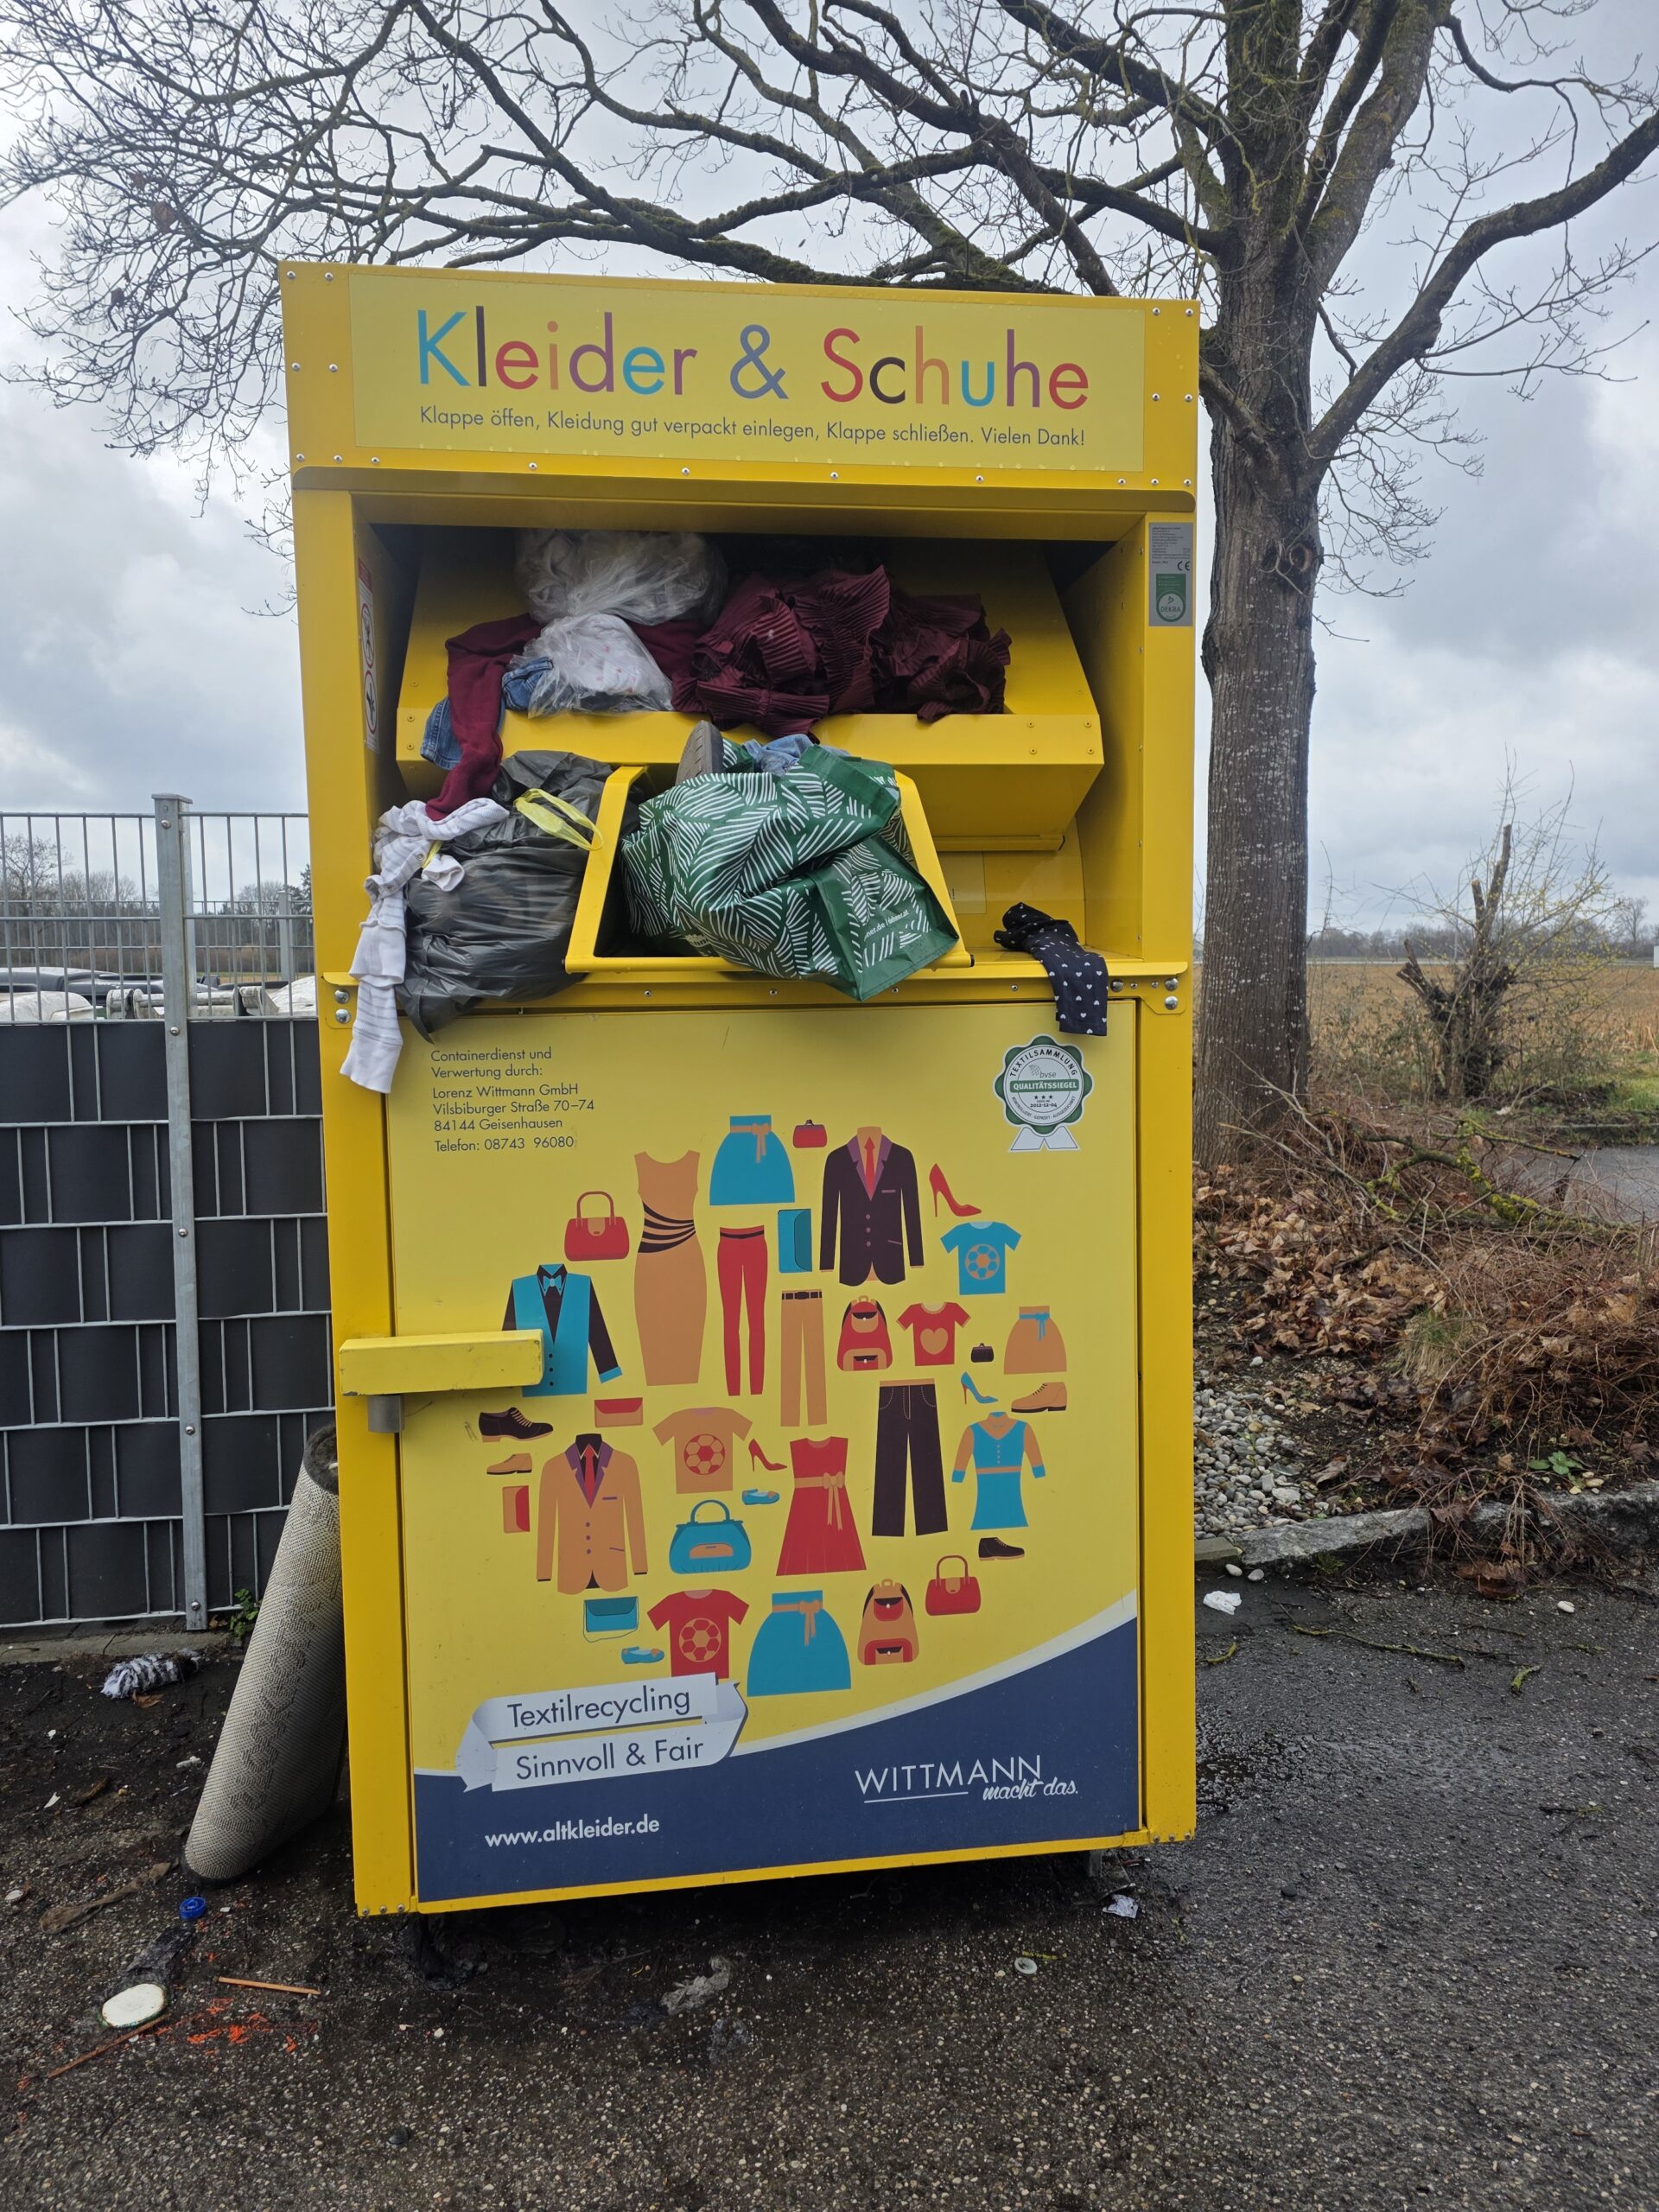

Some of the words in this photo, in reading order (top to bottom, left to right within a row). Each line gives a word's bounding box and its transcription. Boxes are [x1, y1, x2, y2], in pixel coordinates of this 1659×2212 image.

[417, 305, 697, 395] Kleider
[730, 324, 790, 400] &
[821, 325, 1089, 410] Schuhe
[420, 405, 484, 429] Klappe
[490, 408, 540, 430] öffen,
[547, 410, 624, 435] Kleidung
[631, 418, 658, 436] gut
[664, 417, 737, 439] verpackt
[742, 418, 819, 442] einlegen,
[827, 421, 886, 444] Klappe
[893, 423, 974, 443] schließen.
[982, 427, 1031, 444] Vielen
[1038, 429, 1085, 446] Dank!
[430, 1047, 526, 1062] Containerdienst
[530, 1046, 552, 1060] und
[1009, 1049, 1077, 1077] TEXTILSAMMLUNG
[431, 1066, 501, 1080] Verwertung
[505, 1064, 543, 1077] durch:
[433, 1087, 473, 1099] Lorenz
[476, 1085, 536, 1097] Wittmann
[539, 1083, 578, 1096] GmbH
[1014, 1081, 1077, 1090] QUALITÄTSSIEGEL
[433, 1102, 507, 1116] Vilsbiburger
[511, 1099, 550, 1113] Straße
[434, 1120, 475, 1131] 84144
[479, 1116, 563, 1130] Geisenhausen
[435, 1139, 480, 1152] Telefon:
[484, 1137, 525, 1149] 08743
[533, 1136, 575, 1148] 96080
[507, 1685, 690, 1728] Textilrecycling
[516, 1742, 615, 1780] Sinnvoll
[626, 1742, 646, 1766] &
[654, 1737, 703, 1764] Fair
[855, 1755, 1040, 1796] WITTMANN
[982, 1777, 1045, 1801] macht
[1043, 1777, 1078, 1796] das.
[485, 1814, 660, 1847] www.altkleider.de
